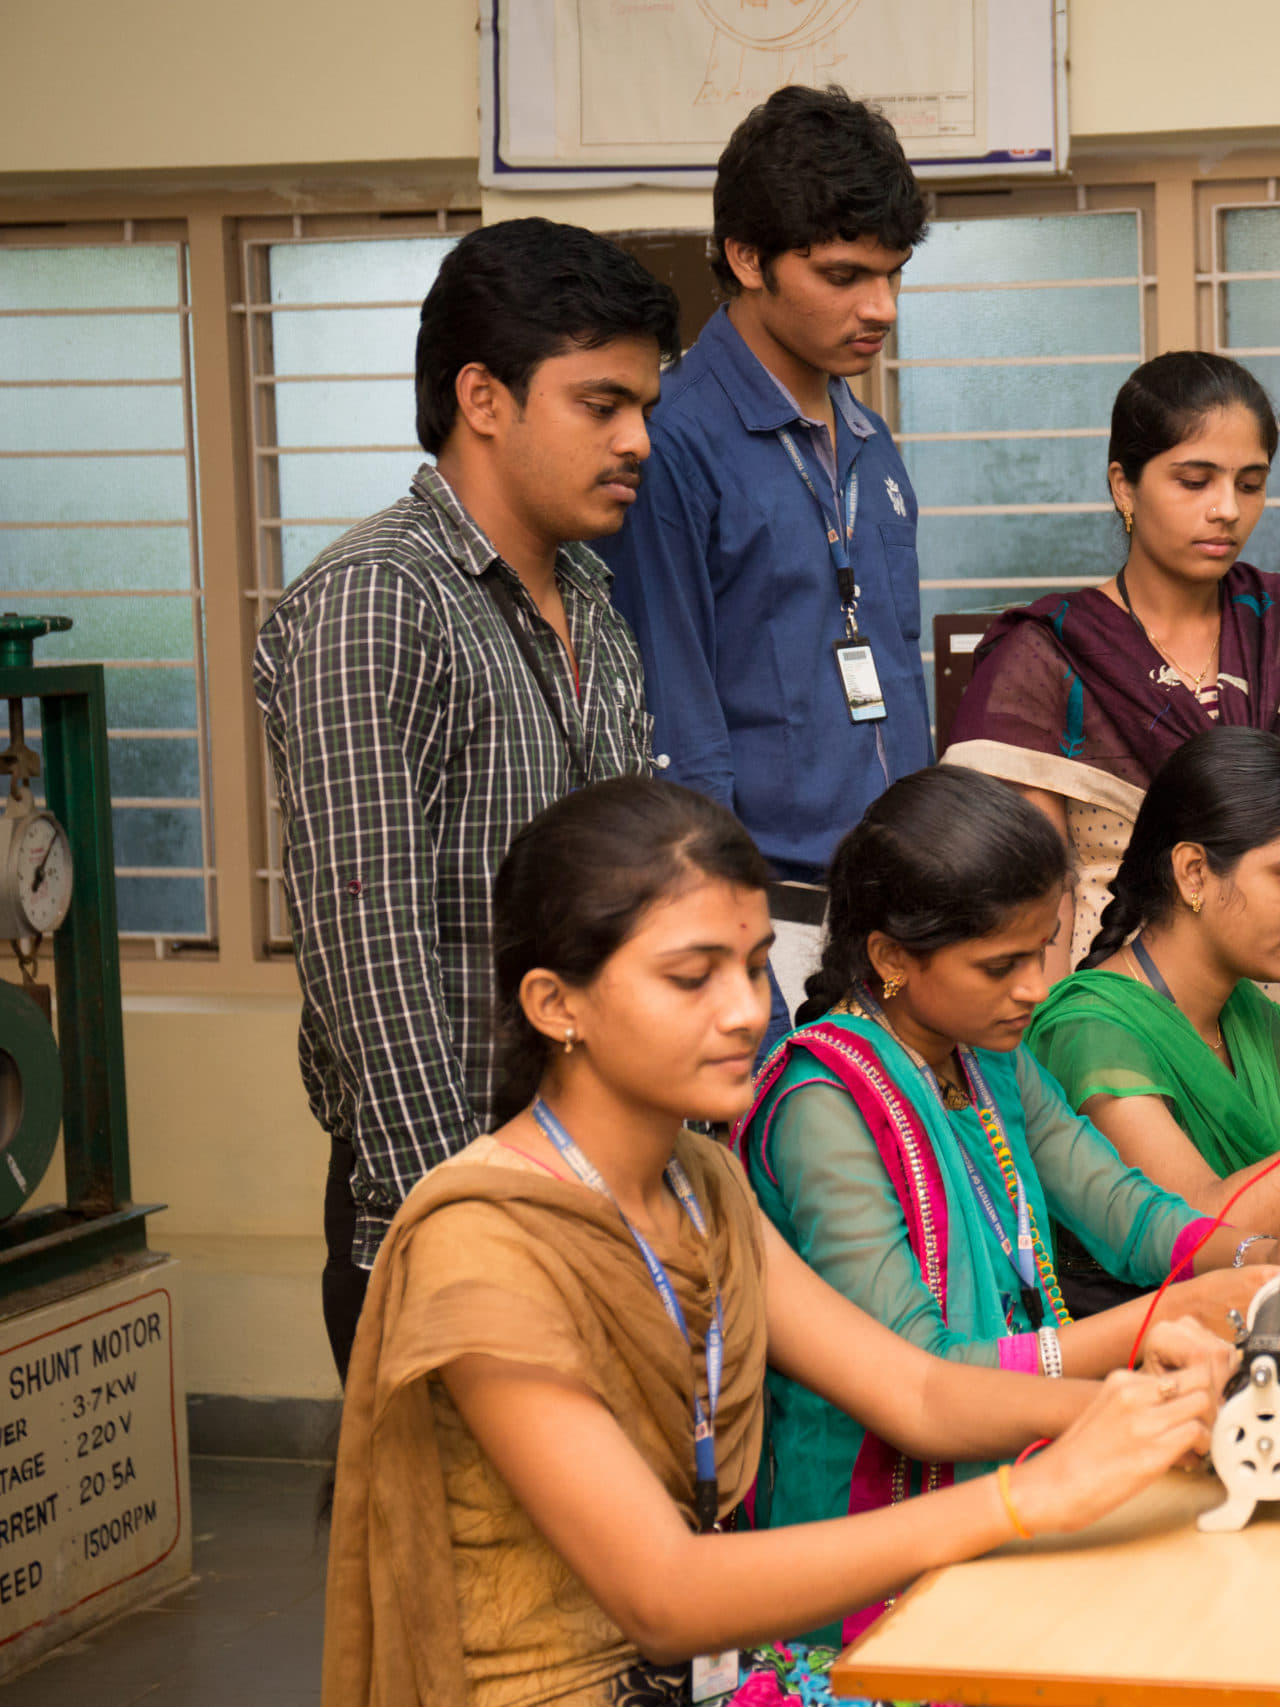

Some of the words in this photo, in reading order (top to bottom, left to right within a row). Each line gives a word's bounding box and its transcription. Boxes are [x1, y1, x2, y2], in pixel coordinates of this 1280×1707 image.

[970, 1172, 981, 1186] OF
[975, 1183, 999, 1223] INSTITUTE
[9, 1344, 82, 1400] SHUNT
[92, 1312, 161, 1368] MOTOR
[84, 1500, 157, 1560] 1500RPM
